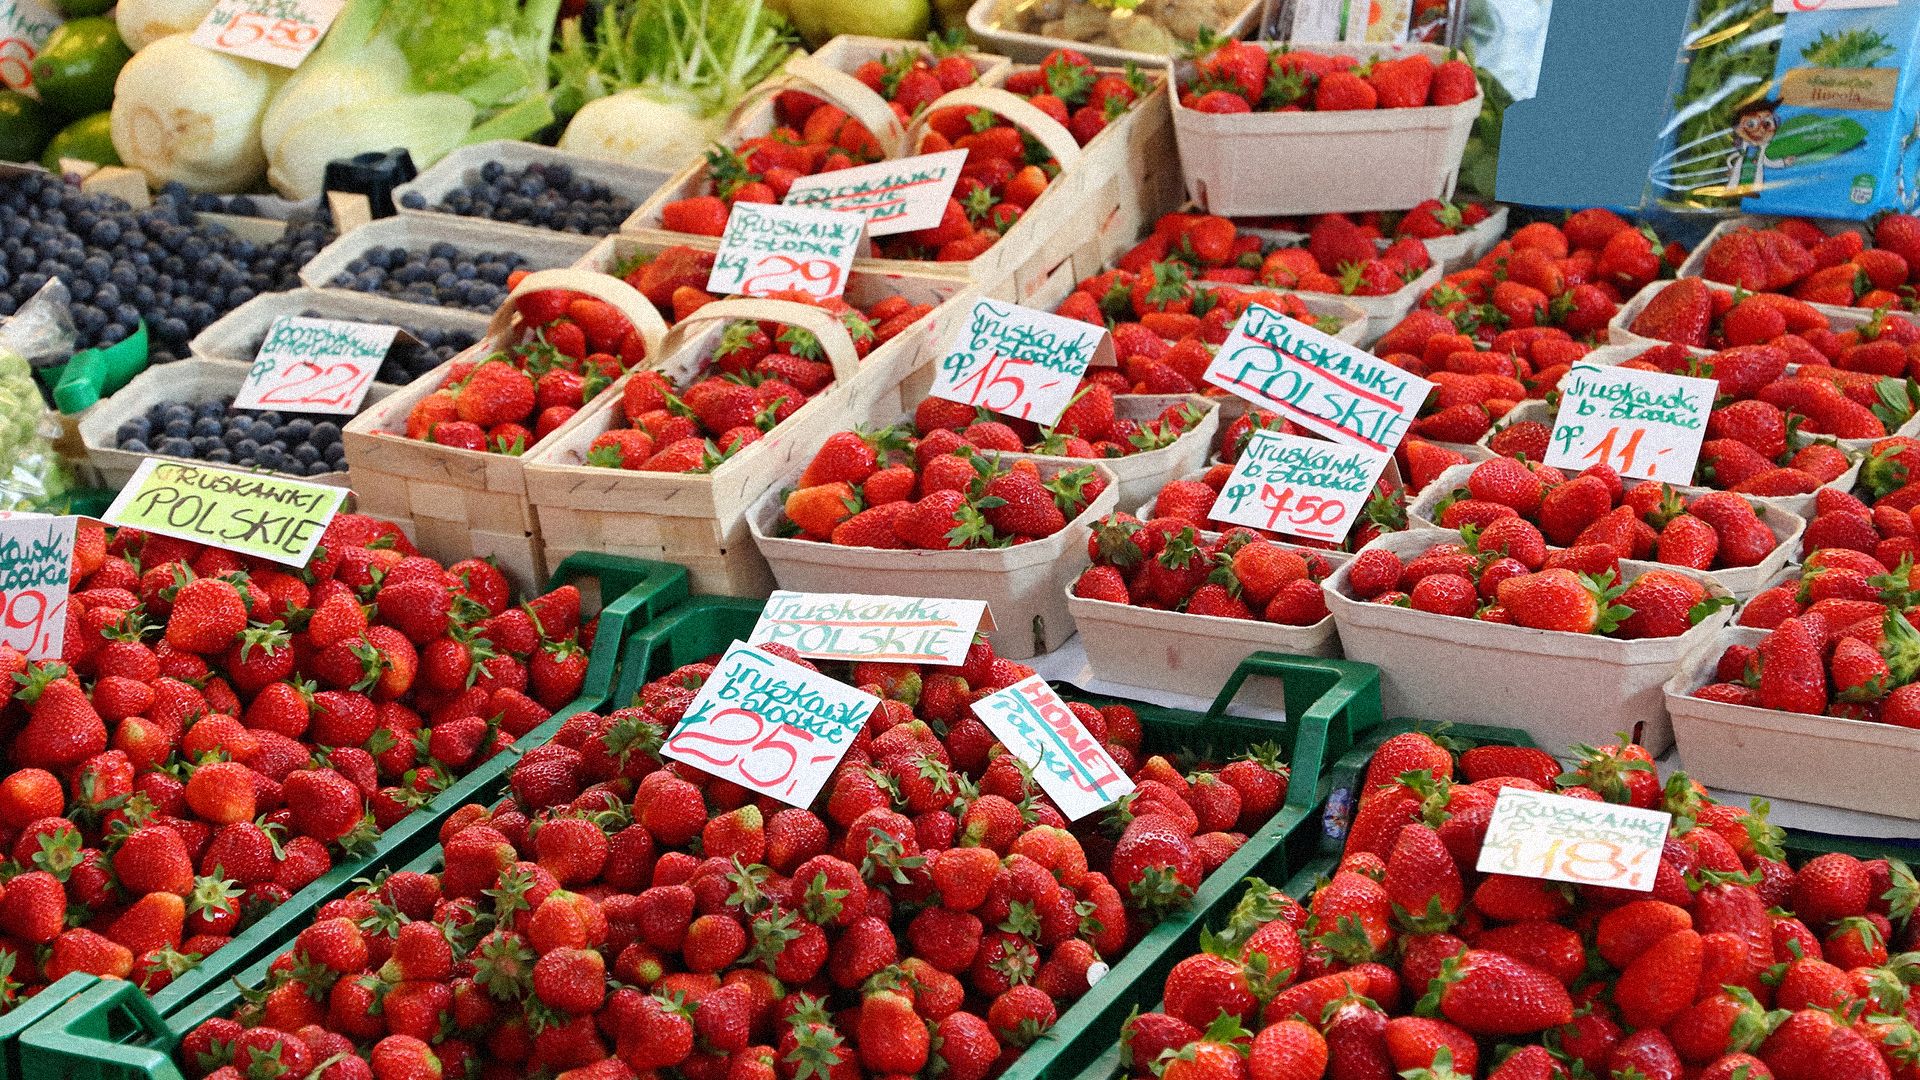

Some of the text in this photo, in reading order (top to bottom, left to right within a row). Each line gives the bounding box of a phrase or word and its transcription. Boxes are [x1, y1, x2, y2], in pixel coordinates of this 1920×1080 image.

[1243, 306, 1408, 402] TRUSKAWKI
[1229, 345, 1411, 449] POLSKIE
[135, 487, 327, 554] POLSKIE
[155, 463, 325, 514] TRUSKAWKI
[758, 621, 967, 656] POLSKIE
